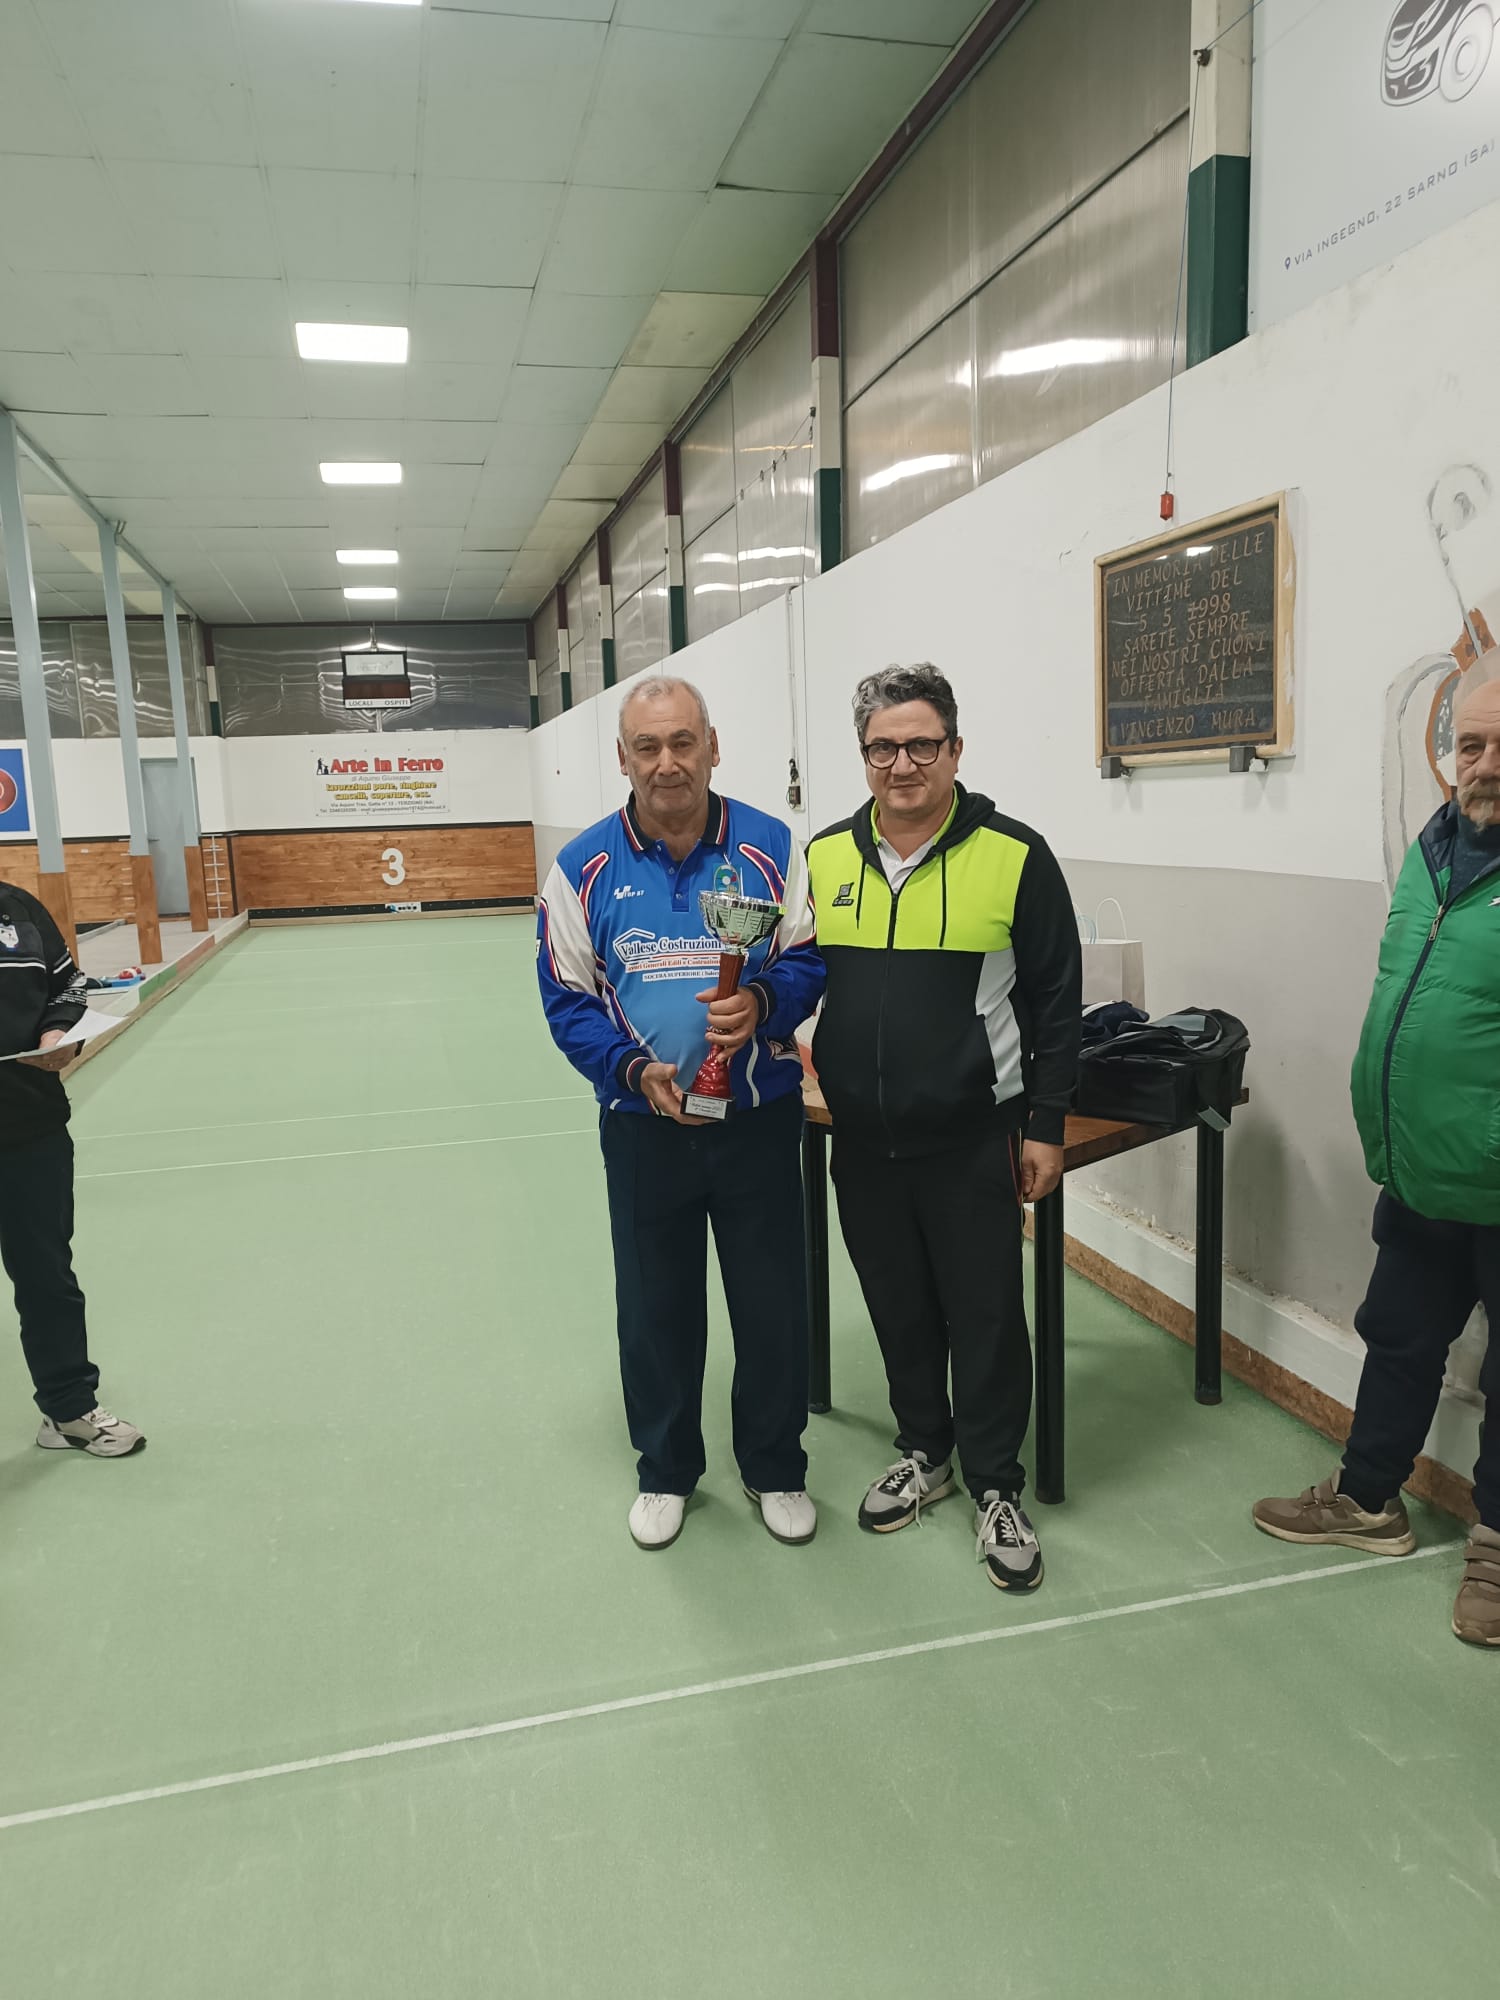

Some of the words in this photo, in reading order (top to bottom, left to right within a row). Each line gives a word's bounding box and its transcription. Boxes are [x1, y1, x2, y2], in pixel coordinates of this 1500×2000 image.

[1294, 249, 1313, 265] VIA
[1317, 210, 1380, 253] INGEGNO,
[1384, 194, 1402, 214] 22
[1407, 161, 1458, 200] SARNO
[1464, 138, 1496, 167] (SA)
[1112, 575, 1130, 597] IN
[1134, 557, 1202, 589] MEMORIA
[1126, 577, 1193, 613] VITTIME
[1210, 565, 1243, 591] DEL
[1123, 627, 1177, 658] SARETE
[1186, 610, 1250, 643] SEMPRE
[1139, 613, 1147, 632] 5
[1162, 607, 1172, 627] 5
[1112, 656, 1136, 678] NEI
[1142, 643, 1200, 673] NOSTRI
[1209, 630, 1266, 660] CUORI
[1120, 667, 1185, 697] OFFERTA
[1198, 656, 1254, 684] DALLA
[1143, 682, 1225, 713] FAMIGLIA
[1120, 714, 1194, 739] VINCENZO
[1211, 707, 1256, 729] MURA
[330, 758, 368, 773] Arte
[397, 757, 444, 771] Ferro
[382, 848, 405, 886] 3
[621, 942, 657, 956] Vallese
